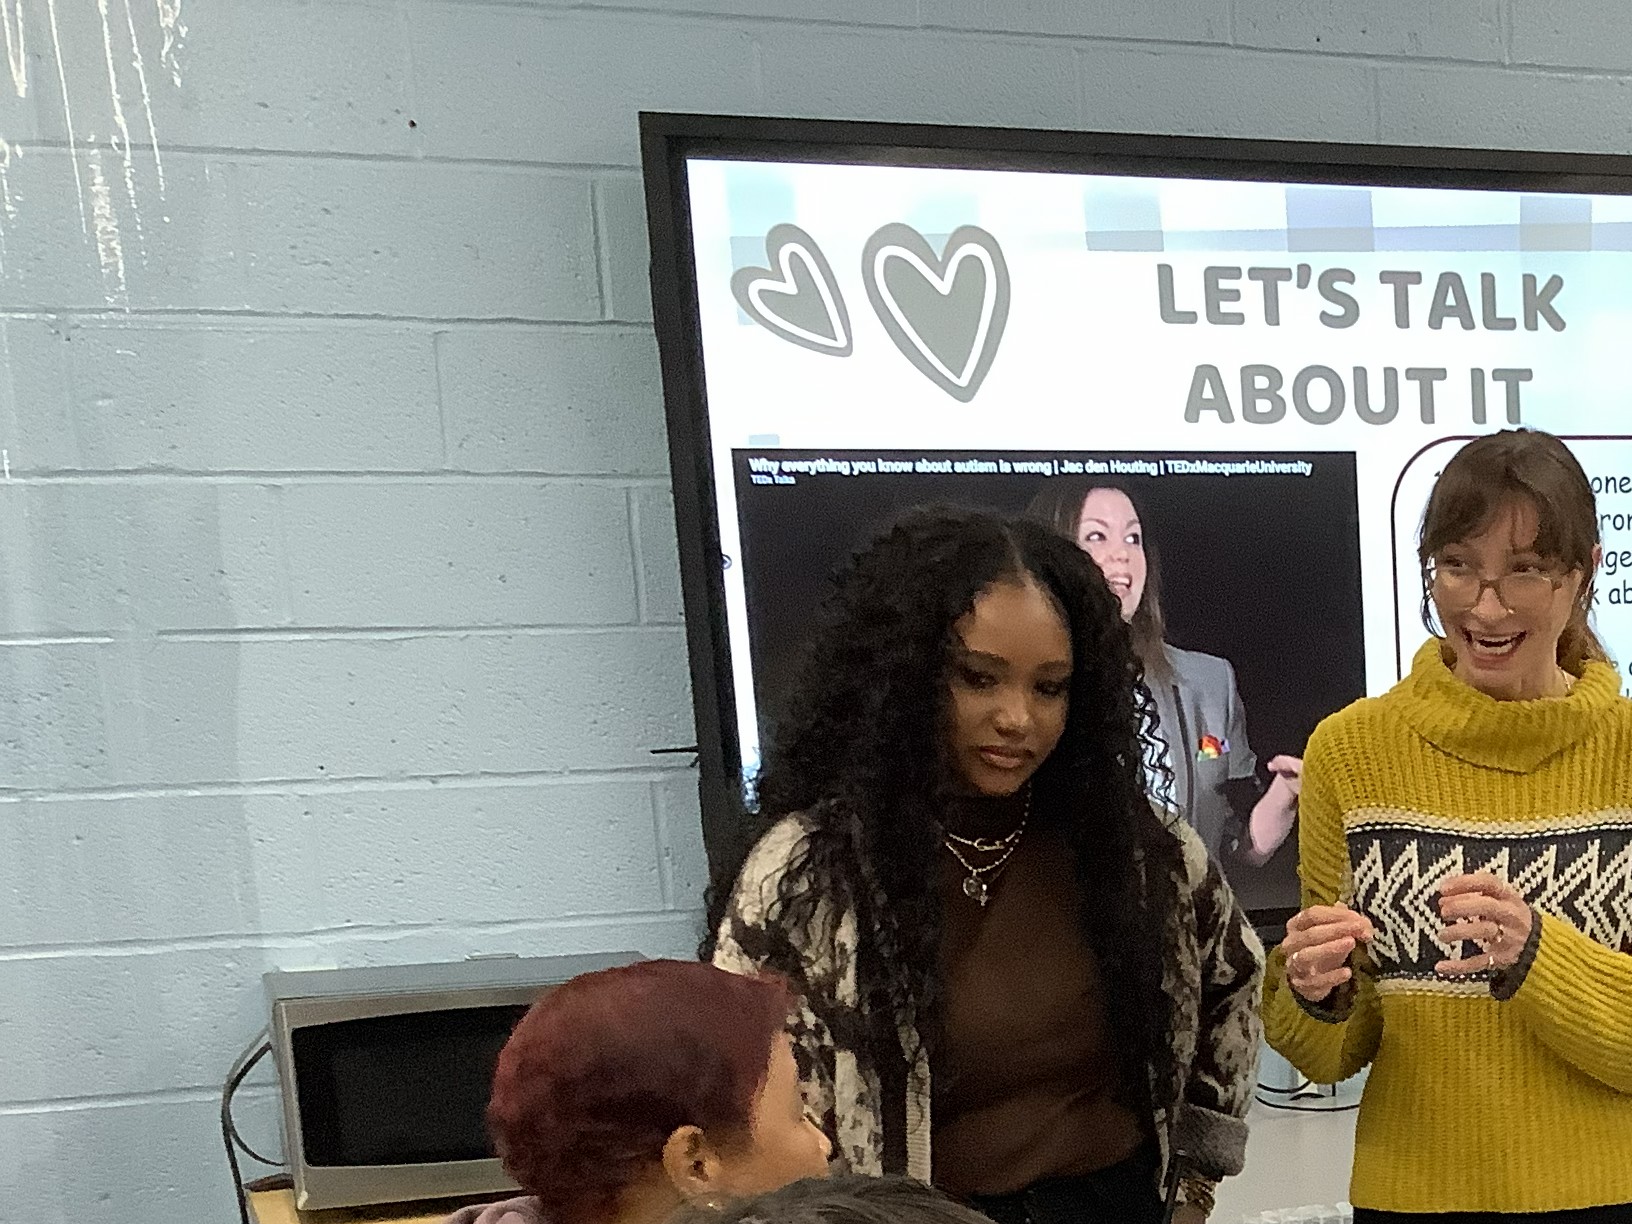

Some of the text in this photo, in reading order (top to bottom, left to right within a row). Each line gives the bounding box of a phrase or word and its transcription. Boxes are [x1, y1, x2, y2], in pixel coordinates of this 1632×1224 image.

[1156, 263, 1567, 332] LET'S TALK
[1184, 364, 1534, 426] ABOUT IT
[749, 458, 780, 475] Why
[780, 458, 850, 476] everything
[851, 462, 876, 476] you
[877, 459, 914, 474] know
[914, 459, 952, 474] about
[953, 459, 997, 474] autism
[999, 459, 1011, 474] is
[1012, 462, 1052, 477] wrong
[1085, 460, 1109, 475] den
[1110, 460, 1158, 477] Houting
[1165, 460, 1313, 477] TEDxMacquarieUniversity
[1590, 475, 1632, 494] one
